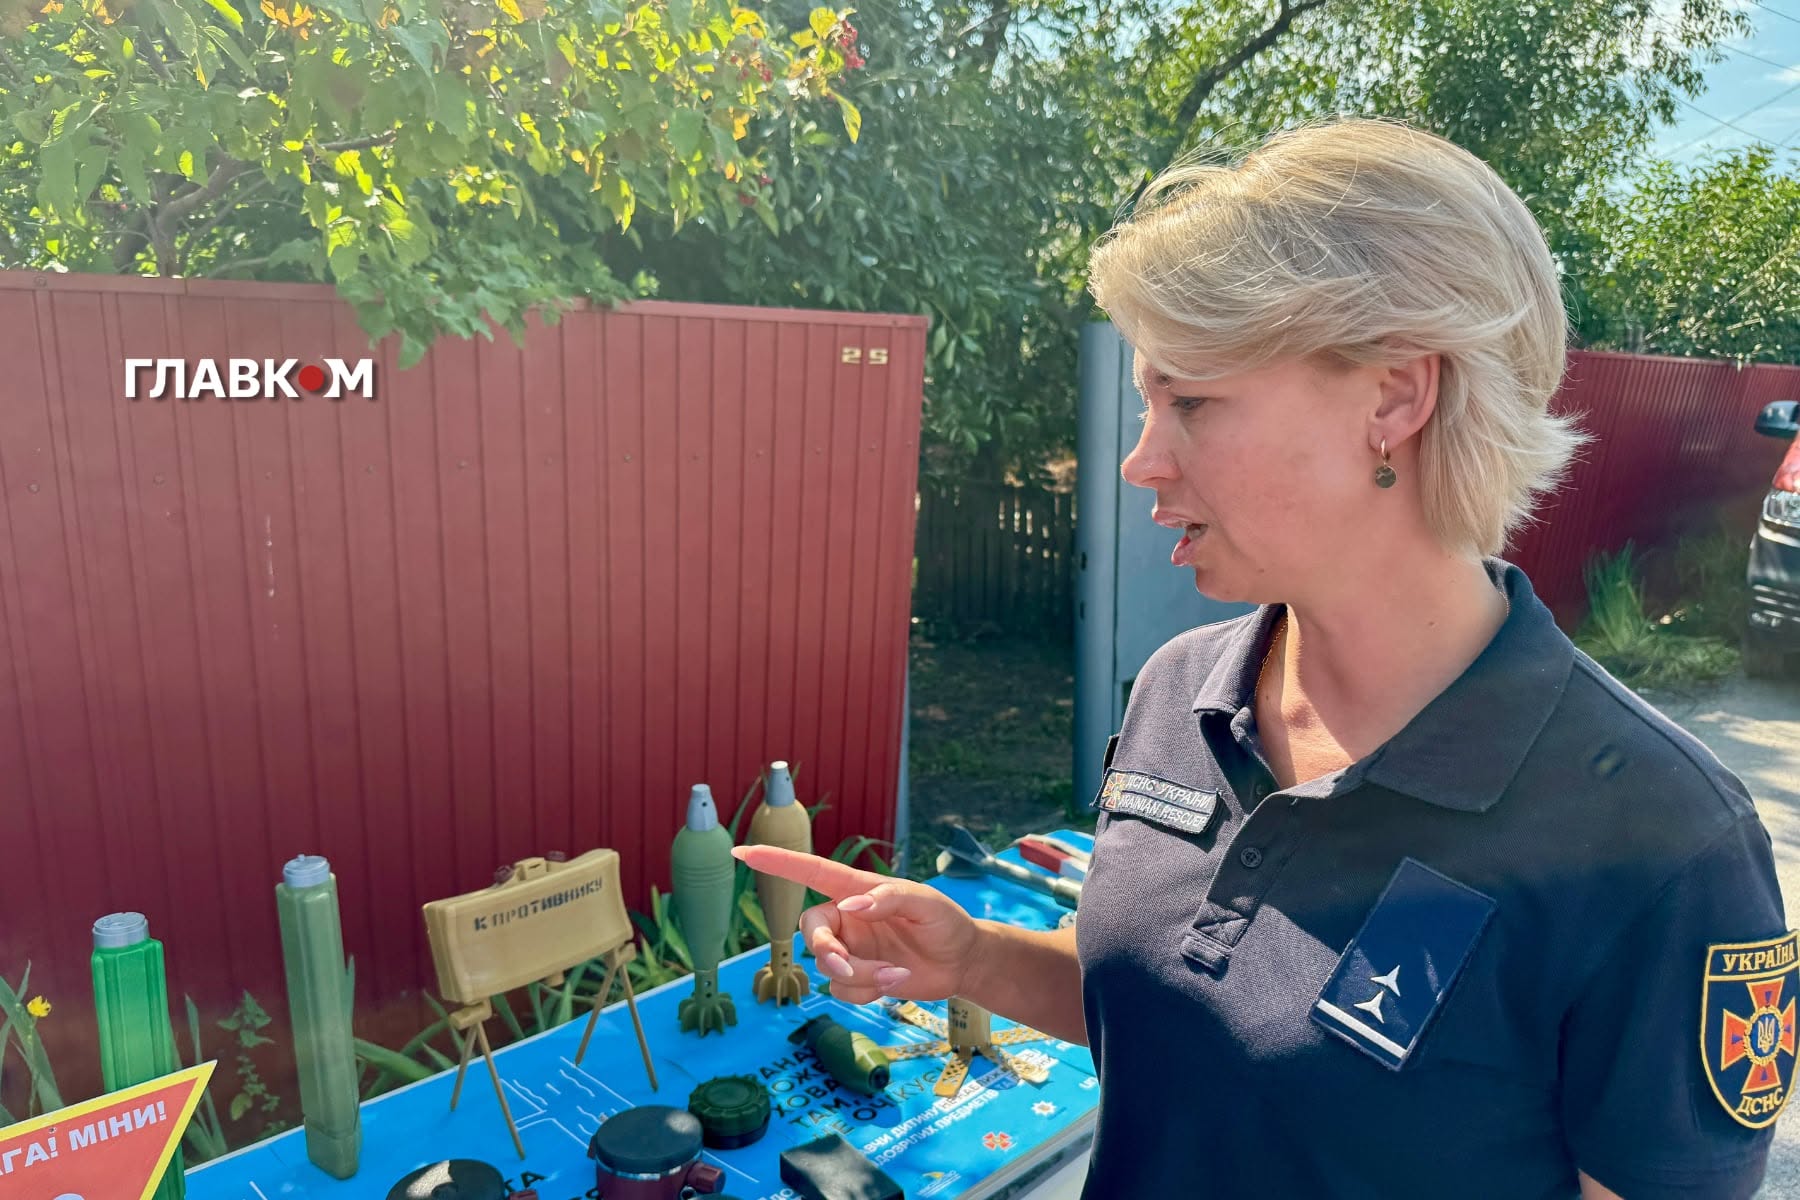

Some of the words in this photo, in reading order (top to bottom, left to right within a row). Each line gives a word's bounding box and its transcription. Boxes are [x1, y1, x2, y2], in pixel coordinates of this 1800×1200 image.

[841, 346, 889, 365] 25
[1125, 775, 1156, 792] ДСНС
[1157, 783, 1212, 810] УКРАЇНИ
[1722, 942, 1795, 973] УКРАЇНА
[853, 1064, 945, 1121] ОЧІКУЄ
[1736, 1087, 1785, 1117] ДСНС
[893, 1106, 939, 1138] ДИТИНУ
[934, 1089, 1000, 1131] ПРЕДМЕТІВ
[0, 1136, 59, 1176] ГА!
[68, 1101, 168, 1151] МІНИ!
